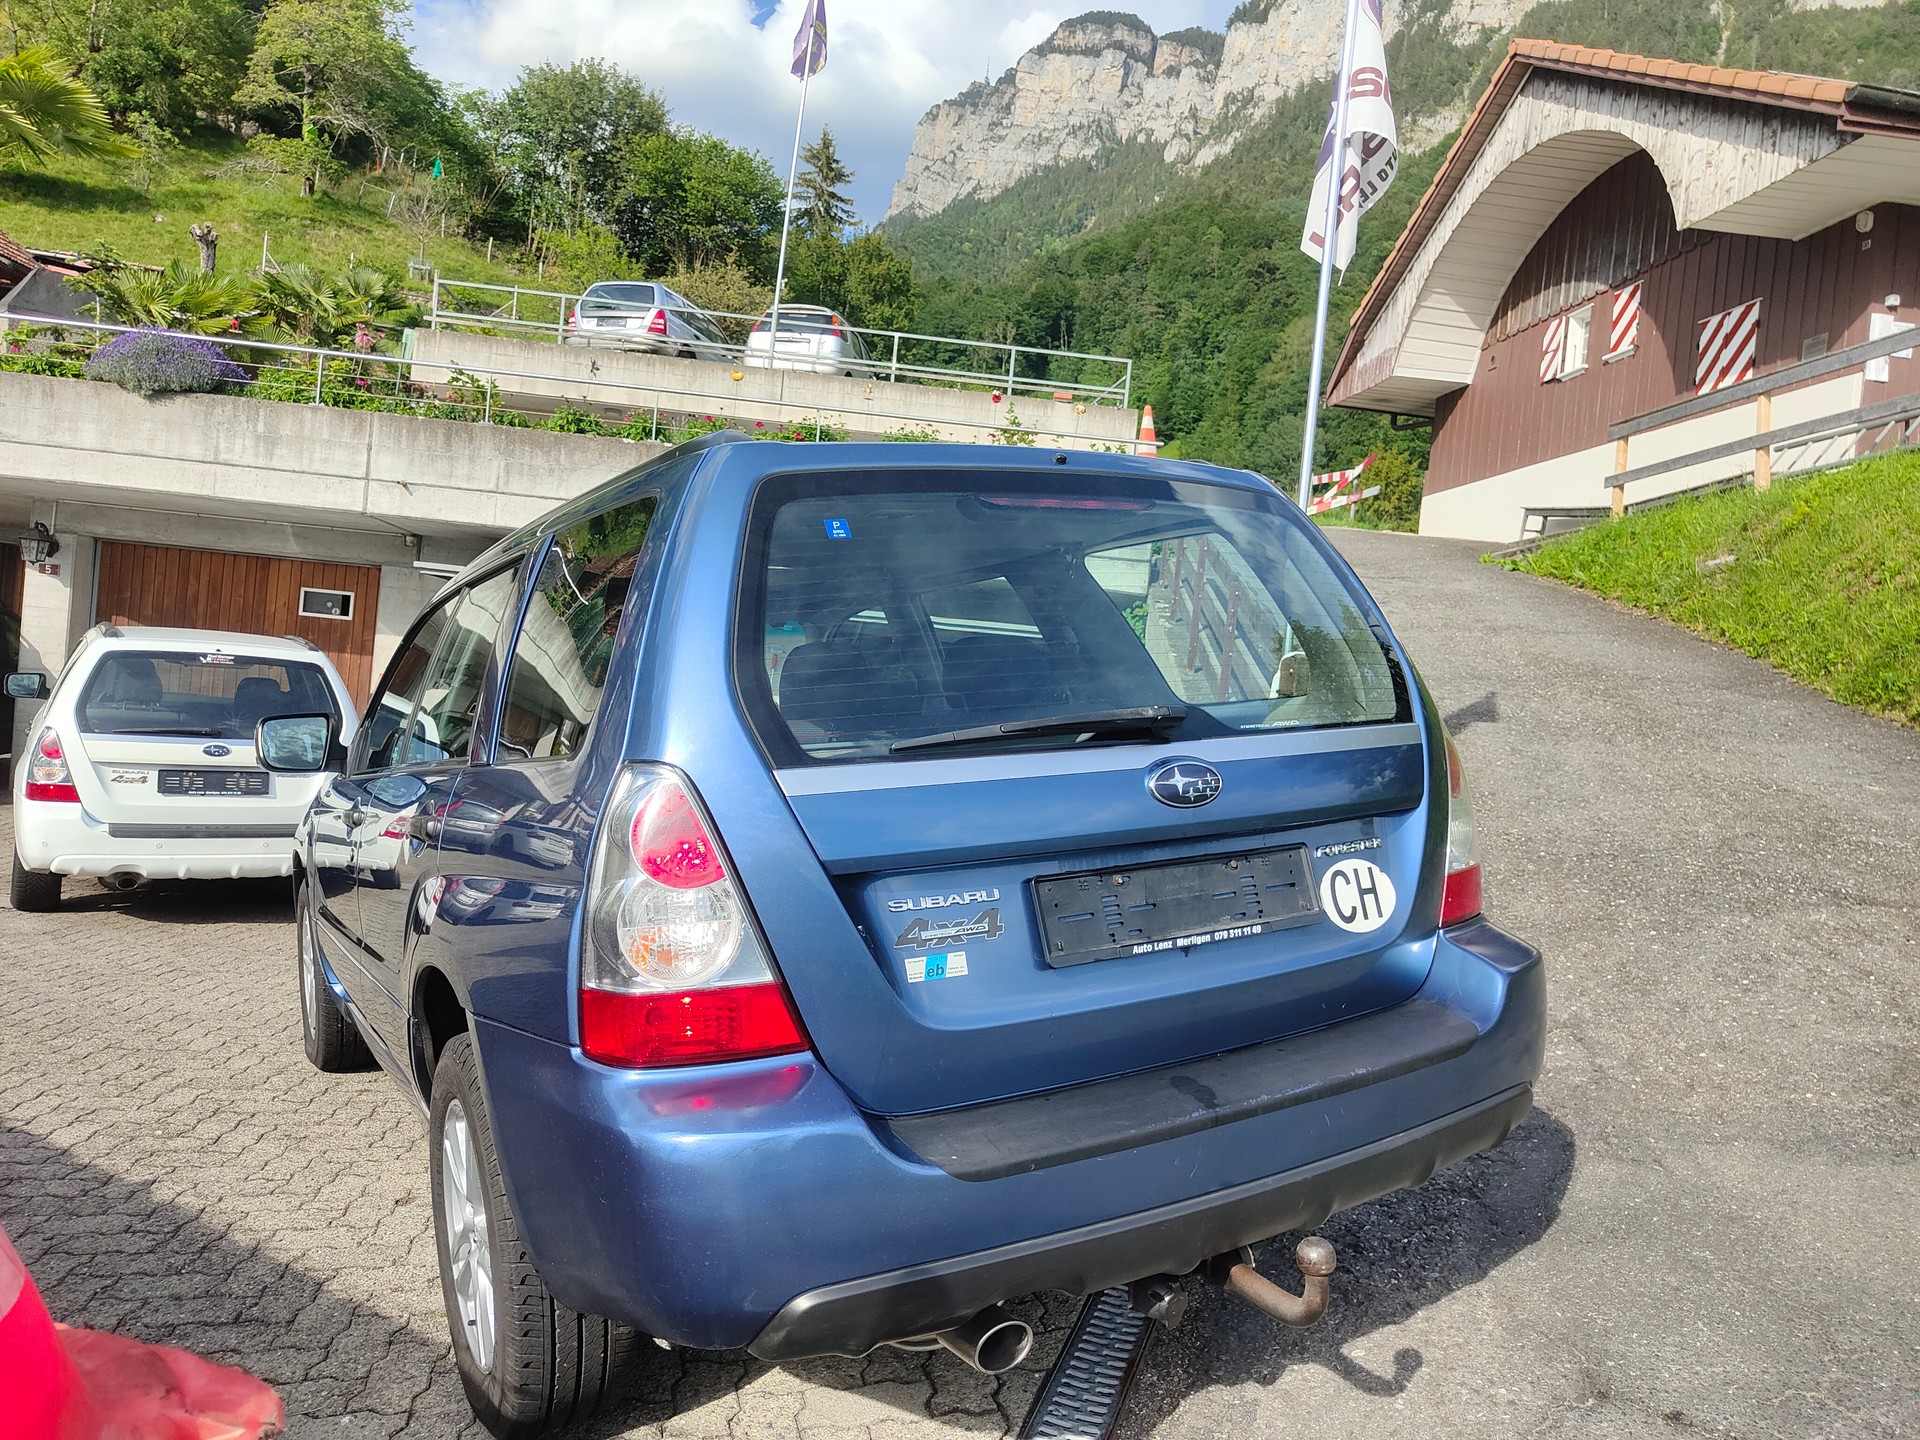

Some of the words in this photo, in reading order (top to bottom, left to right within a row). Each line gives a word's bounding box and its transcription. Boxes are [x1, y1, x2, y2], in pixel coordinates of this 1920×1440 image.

[832, 521, 841, 529] P
[45, 564, 52, 574] 5
[1271, 719, 1300, 727] AWD
[1313, 838, 1382, 858] FORESTER
[887, 888, 1001, 913] SUBARU
[1330, 866, 1384, 925] CH
[954, 925, 987, 935] AWD
[1132, 943, 1153, 955] Auto
[1154, 940, 1173, 951] Lenz
[1176, 934, 1211, 947] Merligen
[1214, 930, 1228, 941] 079
[1229, 928, 1242, 939] 311
[1242, 926, 1251, 936] 11
[1251, 924, 1262, 934] 49
[926, 963, 945, 978] eb
